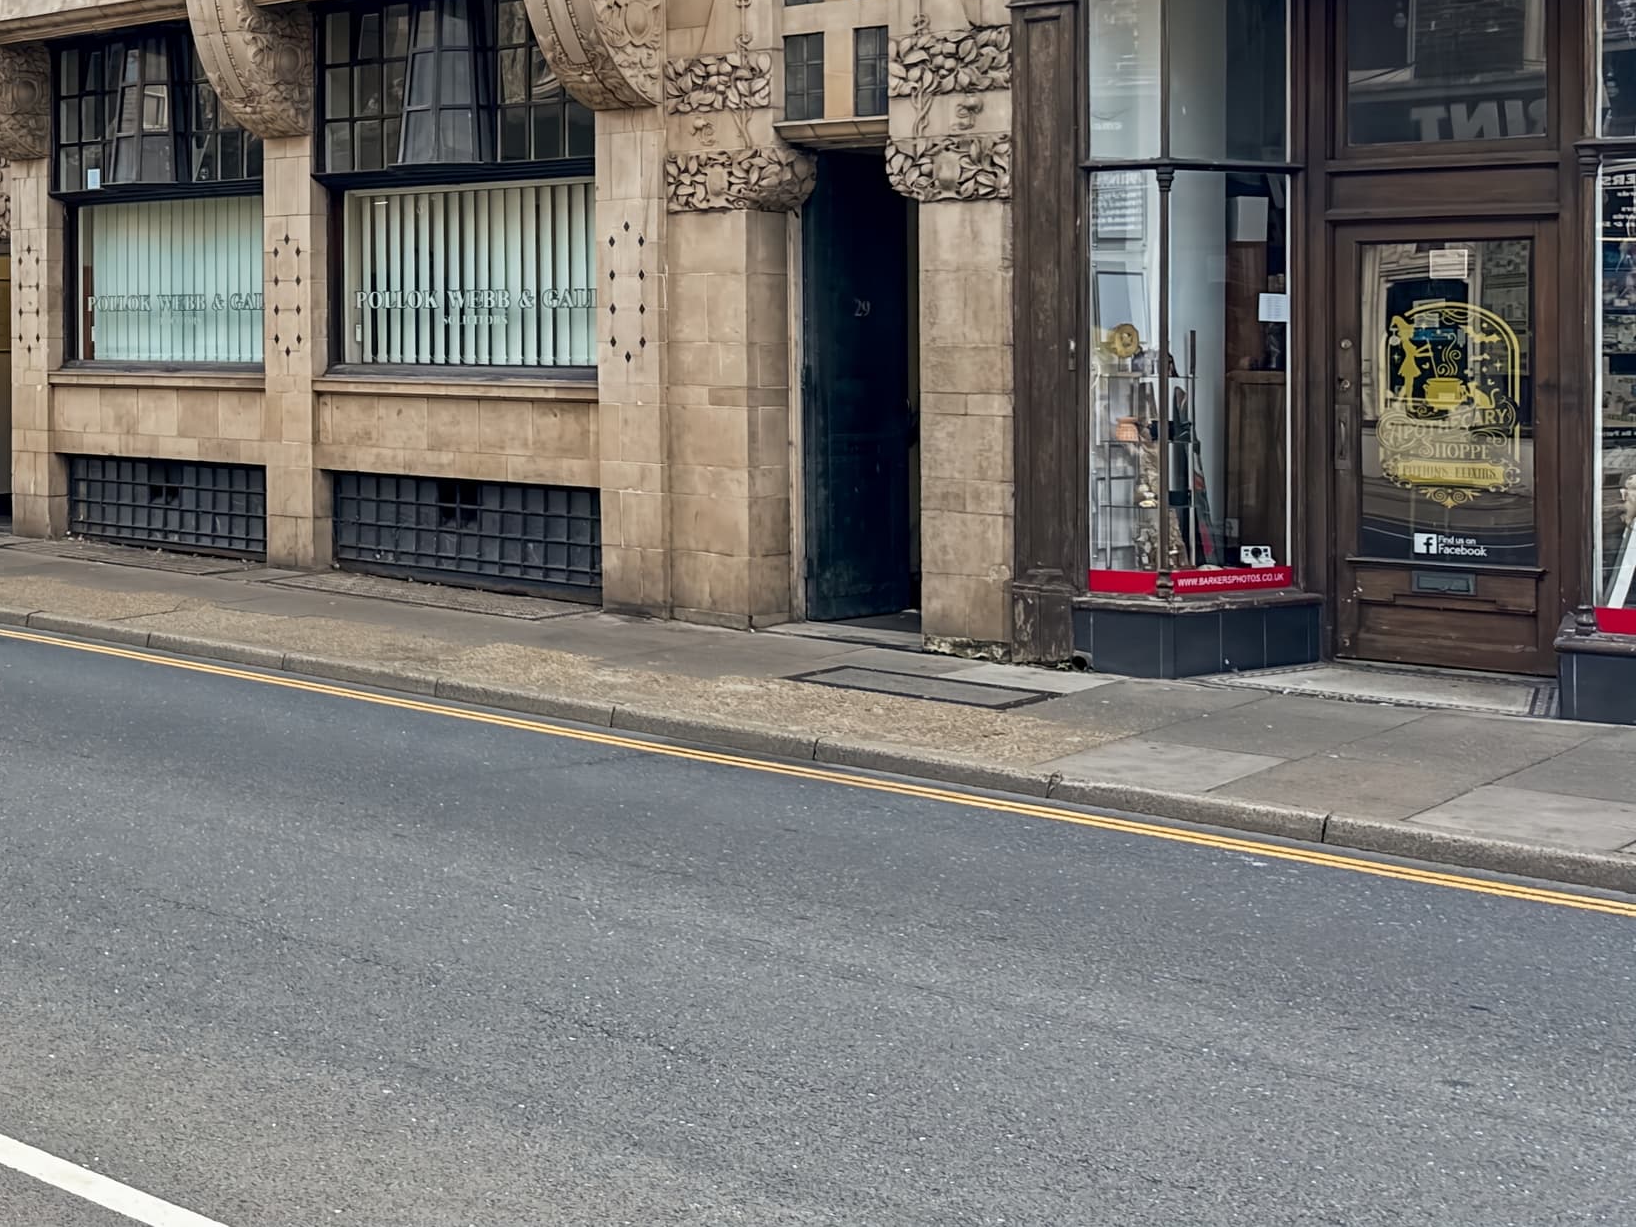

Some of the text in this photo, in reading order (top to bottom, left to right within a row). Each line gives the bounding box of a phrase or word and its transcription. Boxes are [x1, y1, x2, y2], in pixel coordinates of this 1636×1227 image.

[88, 295, 152, 312] POLLOK
[157, 294, 206, 311] WEBB
[212, 293, 225, 311] &
[355, 289, 439, 309] POLLOK
[447, 288, 511, 309] WEBB
[518, 287, 535, 309] &
[853, 298, 871, 317] 29
[443, 314, 508, 325] SOLICITORS
[1385, 408, 1507, 448] APOTHECARY
[1418, 437, 1490, 460] SHOPPE
[1438, 535, 1454, 545] Find
[1438, 544, 1487, 557] Facebook
[1177, 572, 1285, 587] WWW.BARKERSPHOTOS.CO.UK
